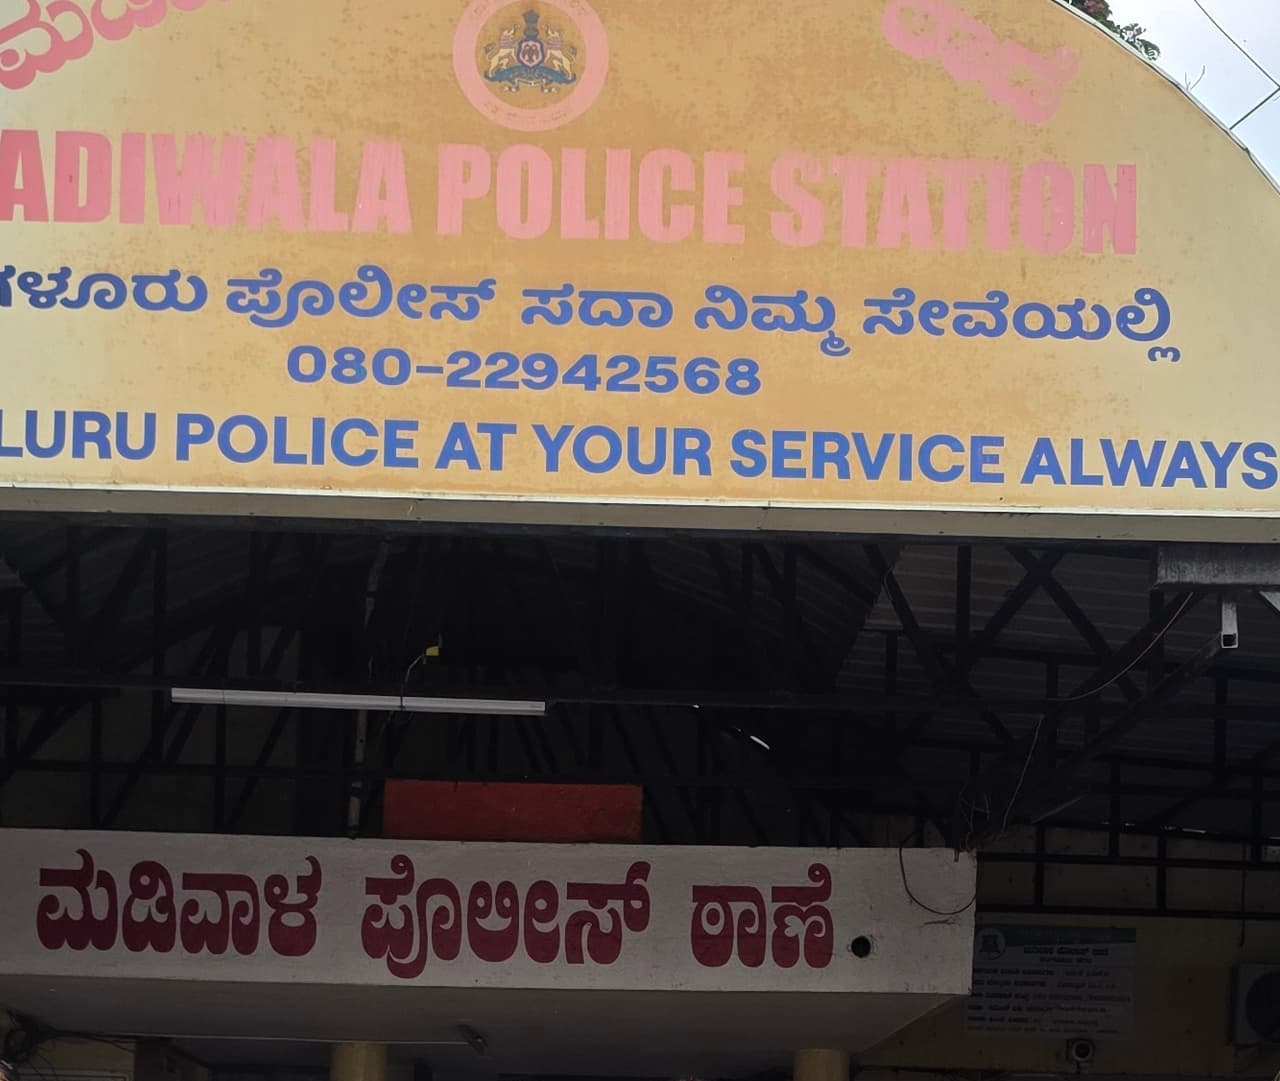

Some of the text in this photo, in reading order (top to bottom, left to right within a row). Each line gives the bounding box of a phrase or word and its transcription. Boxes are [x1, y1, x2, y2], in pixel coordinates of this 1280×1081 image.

[437, 142, 745, 245] POLICE
[769, 154, 1138, 256] STATION
[226, 264, 496, 328] ಪೊಲೀಸ್
[522, 283, 673, 329] ಸದಾ
[694, 283, 850, 357] ನಿಮ್ಮ
[862, 287, 1181, 363] ಸೇವೆಯಲ್ಲಿ
[287, 345, 762, 396] 080-22942568
[175, 412, 420, 469] POLICE
[435, 421, 517, 473] AT
[531, 424, 712, 477] YOUR
[730, 430, 1005, 485] SERVICE
[1020, 437, 1279, 491] ALWAYS
[35, 847, 835, 979] ಮಡಿವಾಳ ಪೊಲೀಸ್ ಠಾಣೆ
